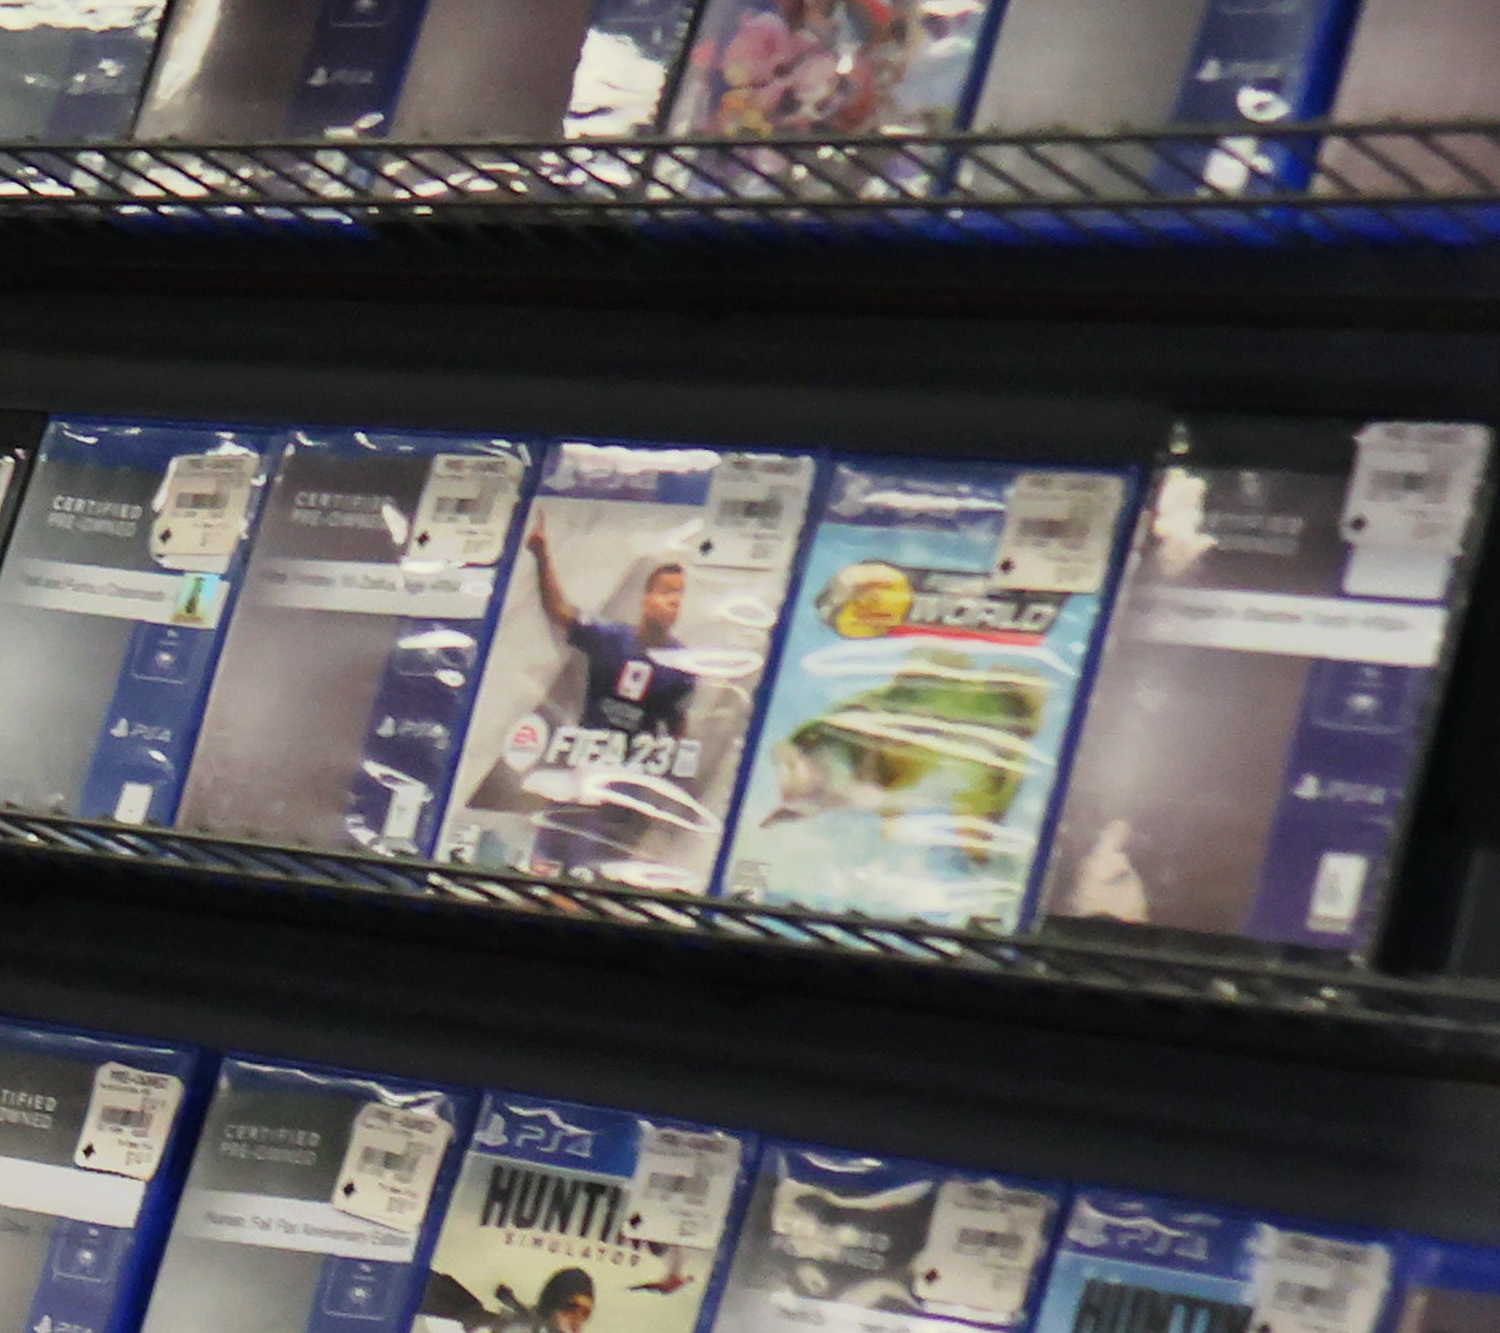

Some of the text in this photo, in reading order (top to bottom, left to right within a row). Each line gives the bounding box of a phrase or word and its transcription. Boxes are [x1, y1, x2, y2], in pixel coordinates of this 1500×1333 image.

[548, 728, 674, 773] FIFA 23
[480, 1164, 667, 1256] HUNTI
[505, 1231, 642, 1268] SIMULATOR
